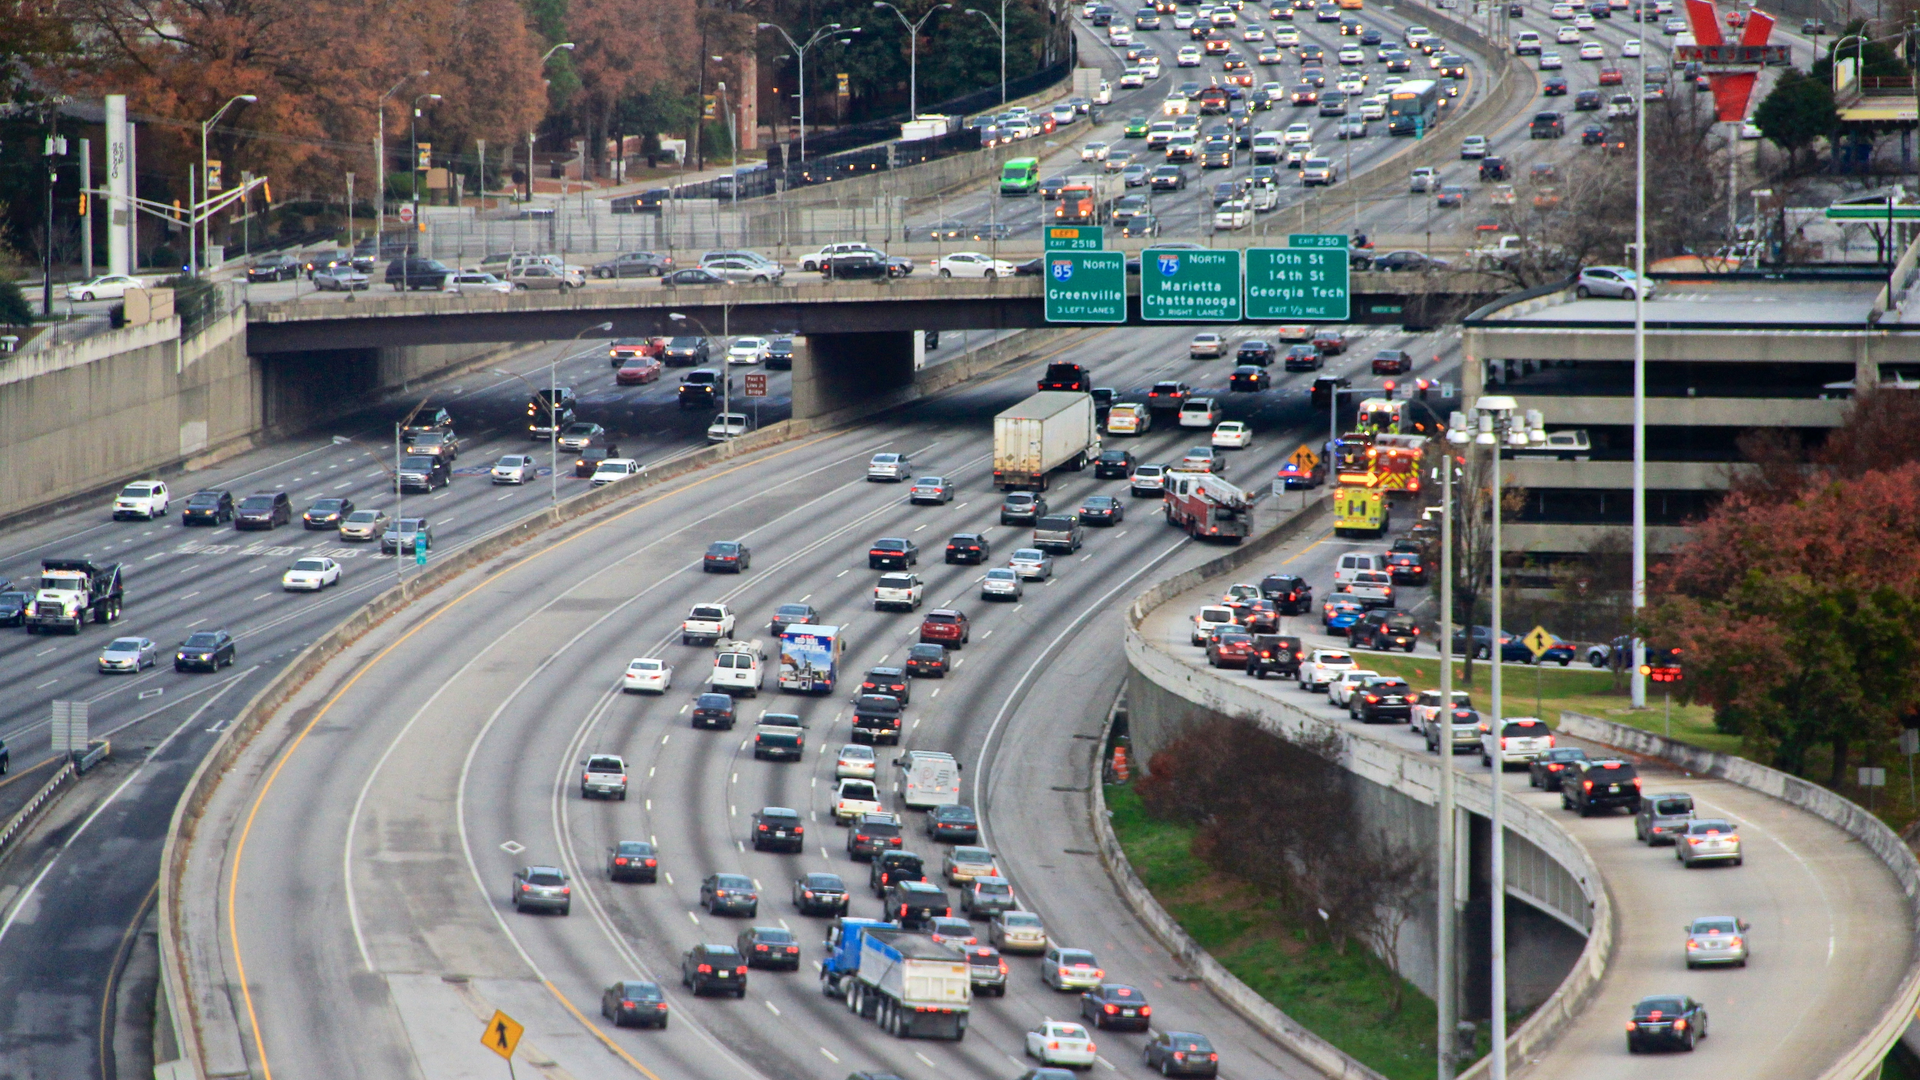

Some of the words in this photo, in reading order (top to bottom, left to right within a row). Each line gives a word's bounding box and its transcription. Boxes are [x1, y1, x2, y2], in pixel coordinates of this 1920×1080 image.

[1679, 49, 1785, 60] VARSITY
[1071, 240, 1096, 248] 251B
[1317, 237, 1339, 246] 250
[1269, 253, 1302, 264] 10th
[1309, 253, 1324, 264] St
[1054, 265, 1072, 278] 85
[1160, 259, 1178, 273] 75
[1269, 270, 1303, 281] 14th
[1310, 270, 1324, 281] St
[1161, 280, 1222, 292] Marietta
[1049, 289, 1122, 300] Greenville
[1250, 286, 1304, 300] Georgia
[1311, 286, 1345, 298] Tech
[1146, 294, 1236, 308] Chattanooga
[1057, 306, 1063, 314] 3
[1065, 306, 1085, 314] LEFT
[1196, 309, 1225, 317] LANES
[1269, 306, 1287, 314] EXIT
[1306, 307, 1325, 315] MILE
